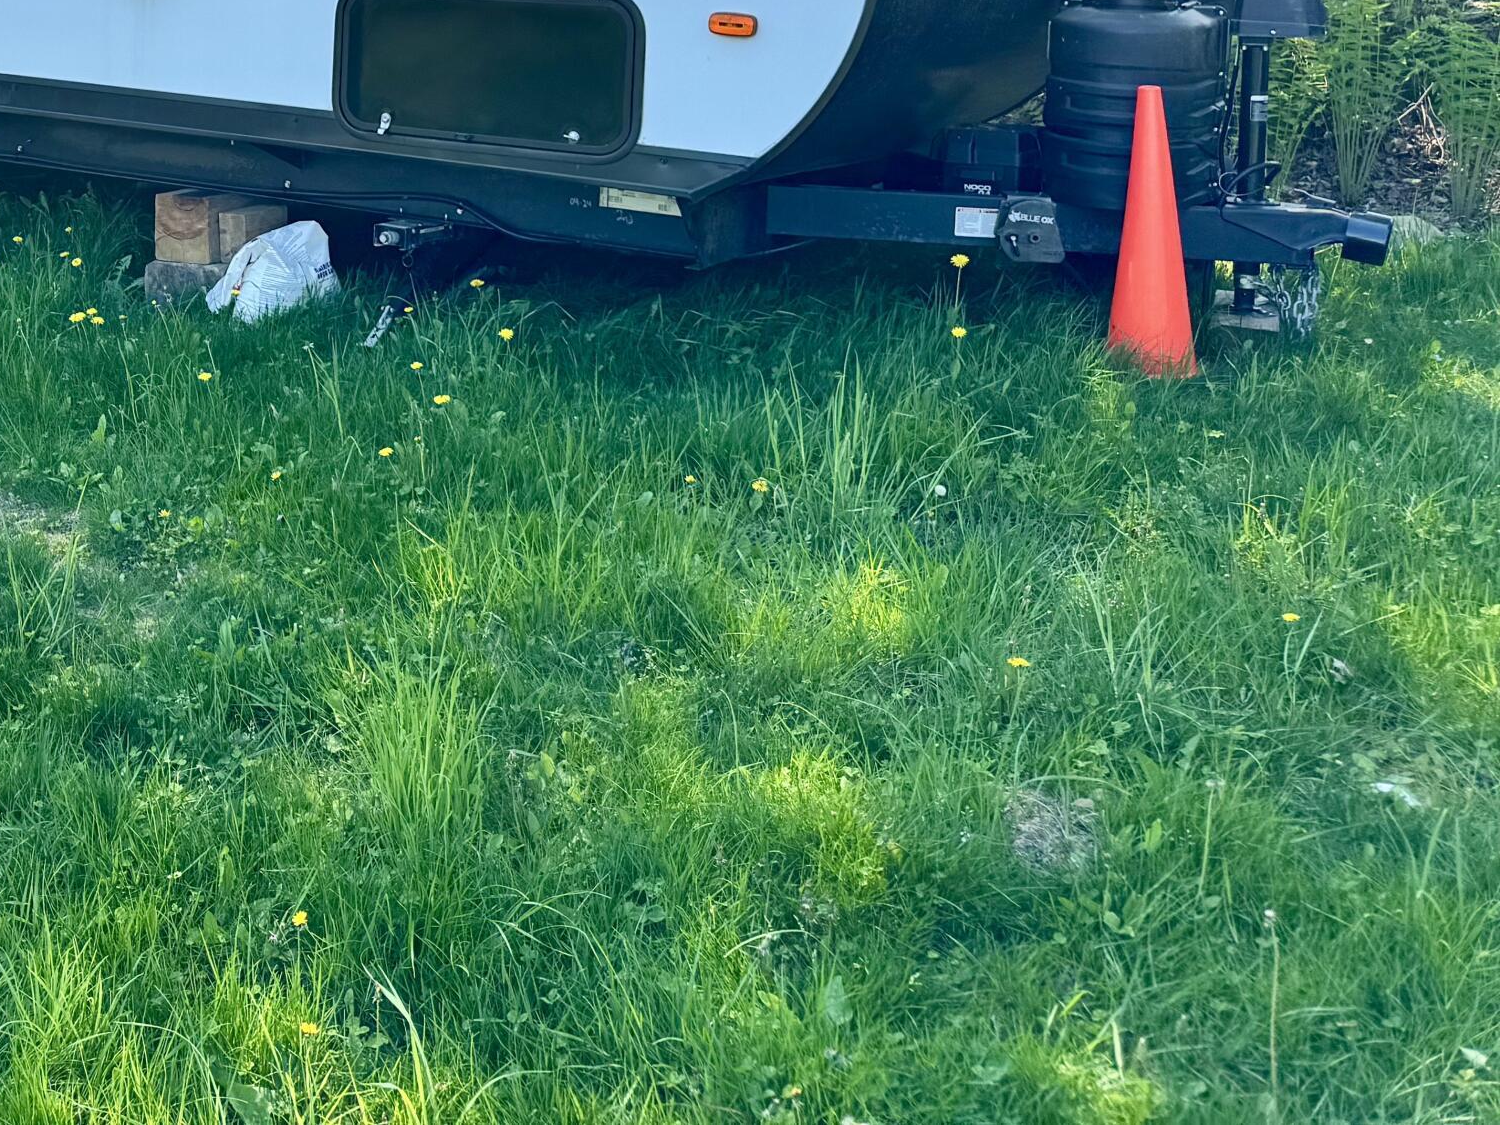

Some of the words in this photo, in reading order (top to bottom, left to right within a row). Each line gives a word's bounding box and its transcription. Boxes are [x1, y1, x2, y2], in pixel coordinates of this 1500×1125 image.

[963, 183, 992, 191] NOCO
[1020, 213, 1041, 223] BLUE
[1041, 216, 1055, 225] OX
